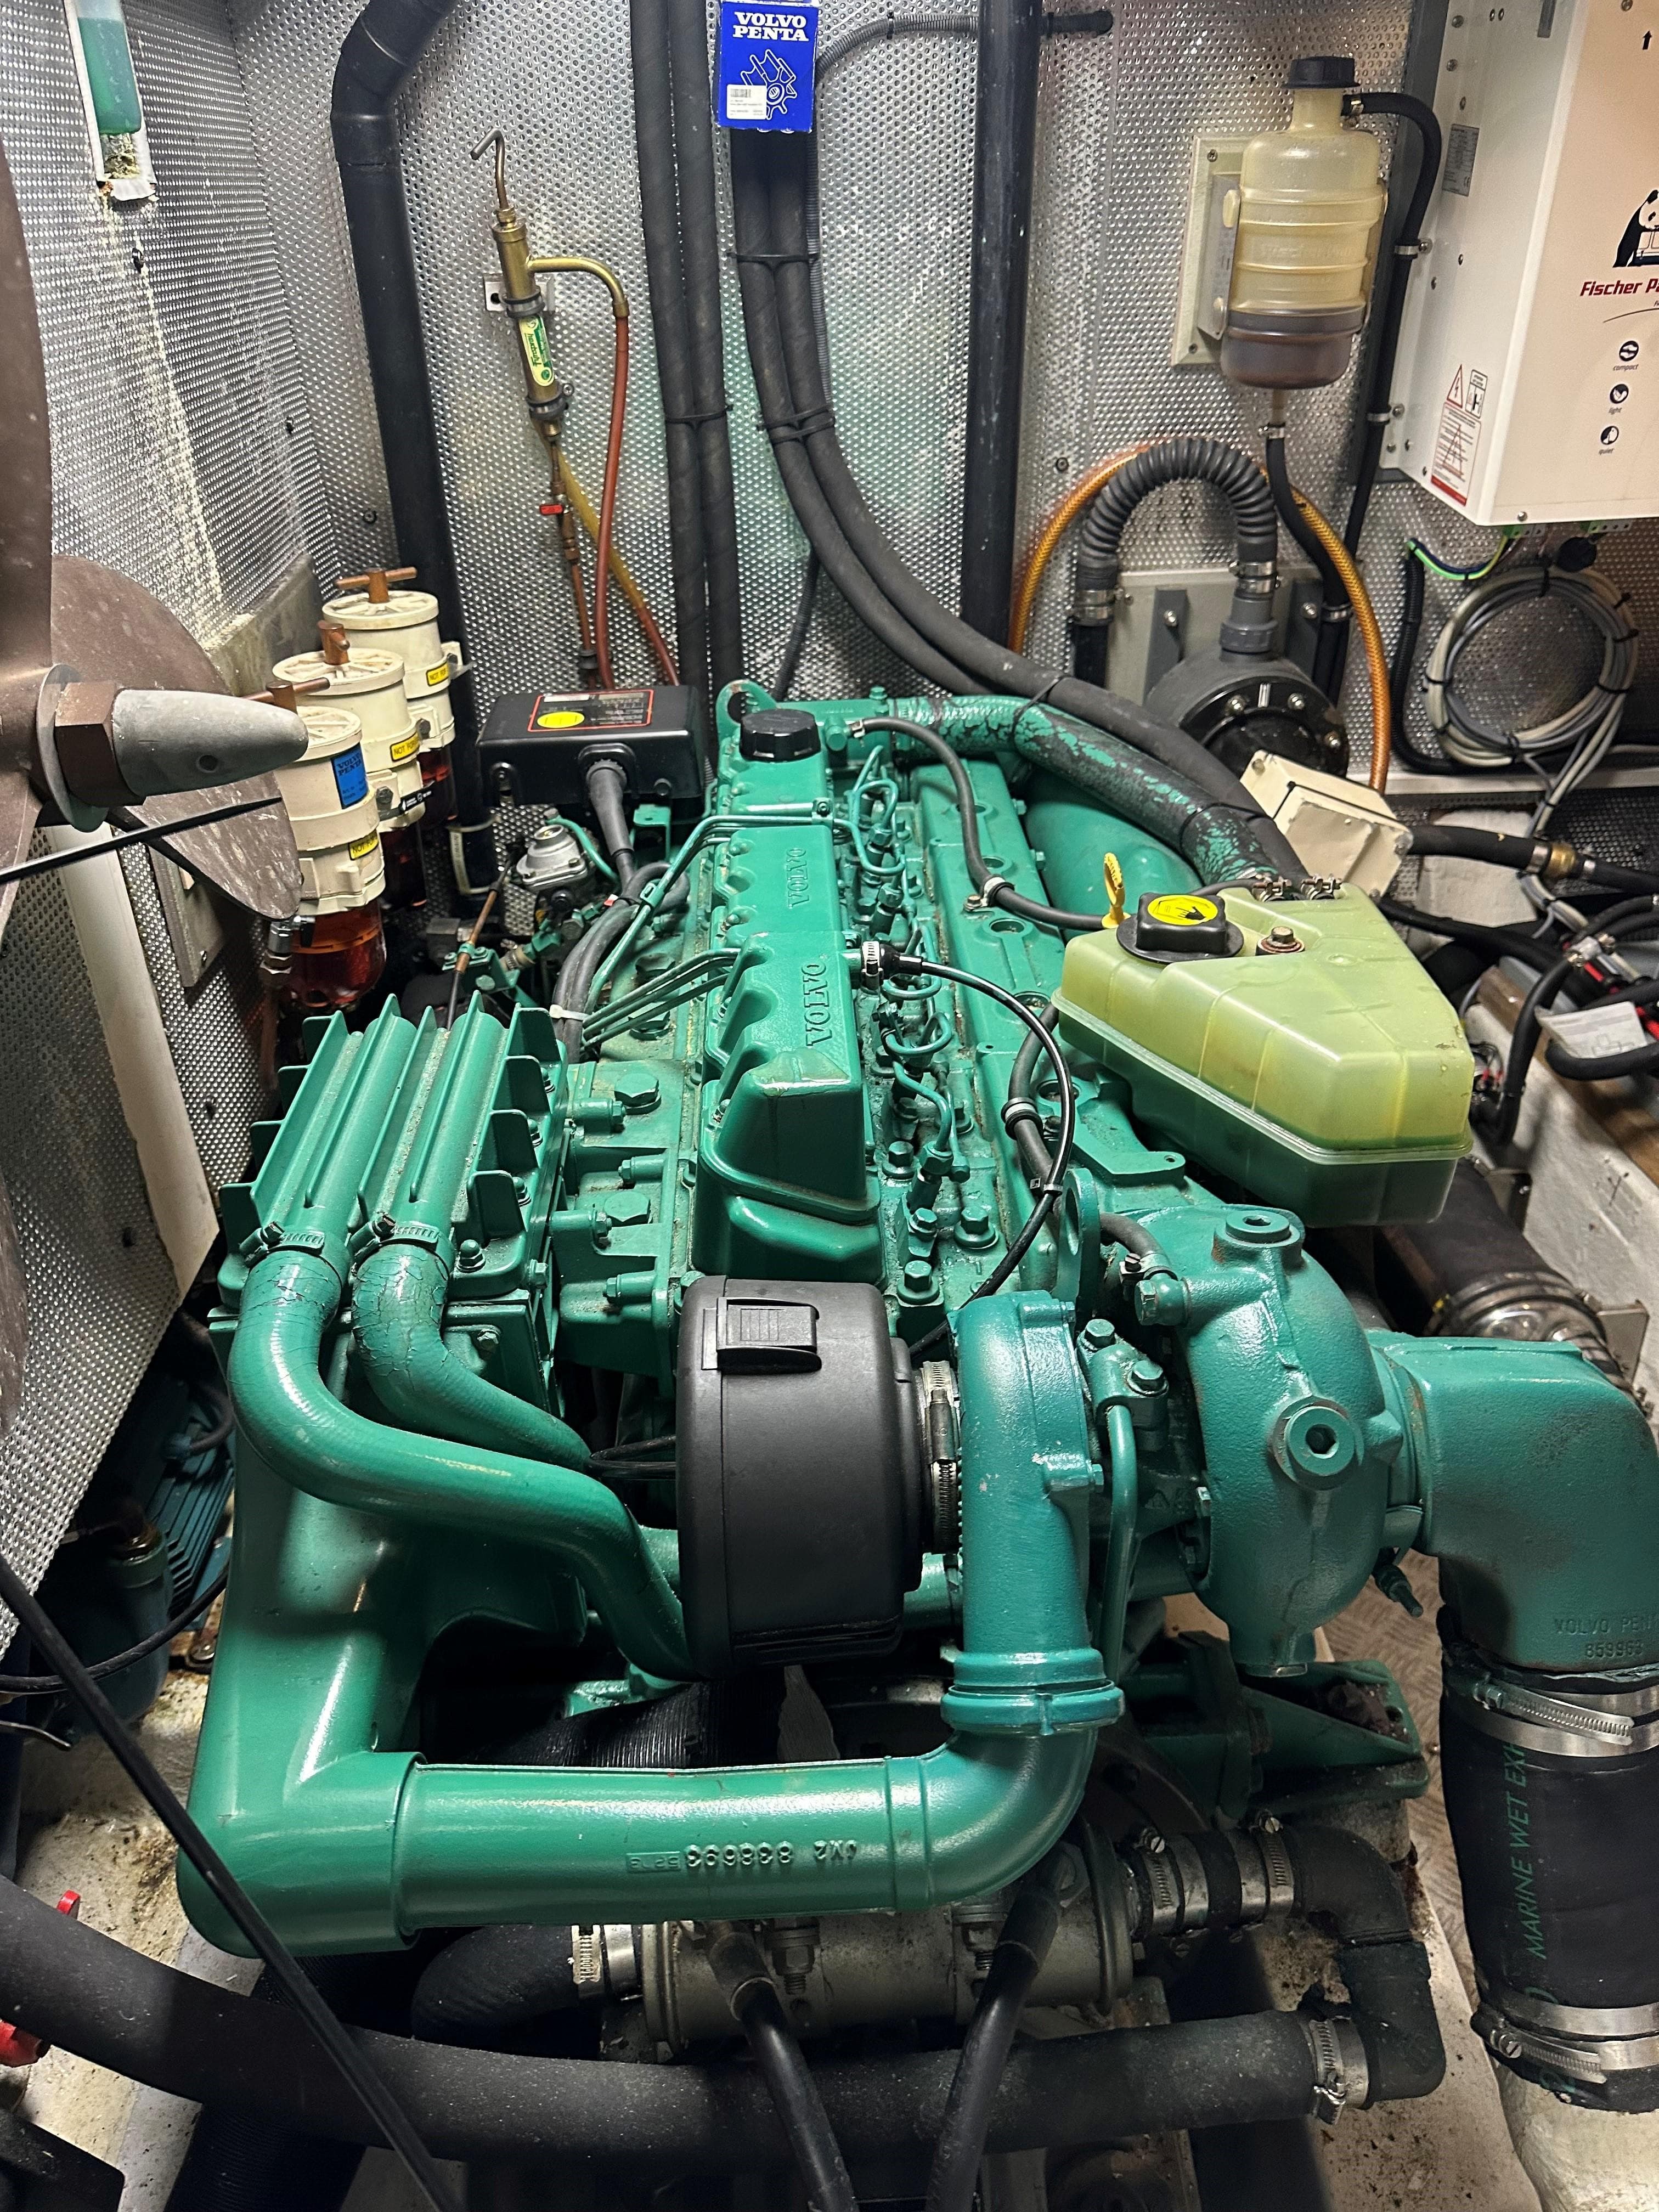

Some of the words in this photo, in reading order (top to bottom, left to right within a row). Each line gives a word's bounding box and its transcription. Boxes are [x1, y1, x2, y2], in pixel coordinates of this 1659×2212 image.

[734, 12, 806, 28] VOLVO
[733, 25, 809, 42] PENTA
[1580, 280, 1643, 296] Fischer
[393, 746, 405, 755] NOT
[786, 848, 809, 909] VOLVO
[802, 963, 832, 1047] VOLVO
[1554, 1618, 1611, 1635] VOLVO
[1506, 1791, 1531, 1847] WET
[1511, 1857, 1547, 1960] MARINE
